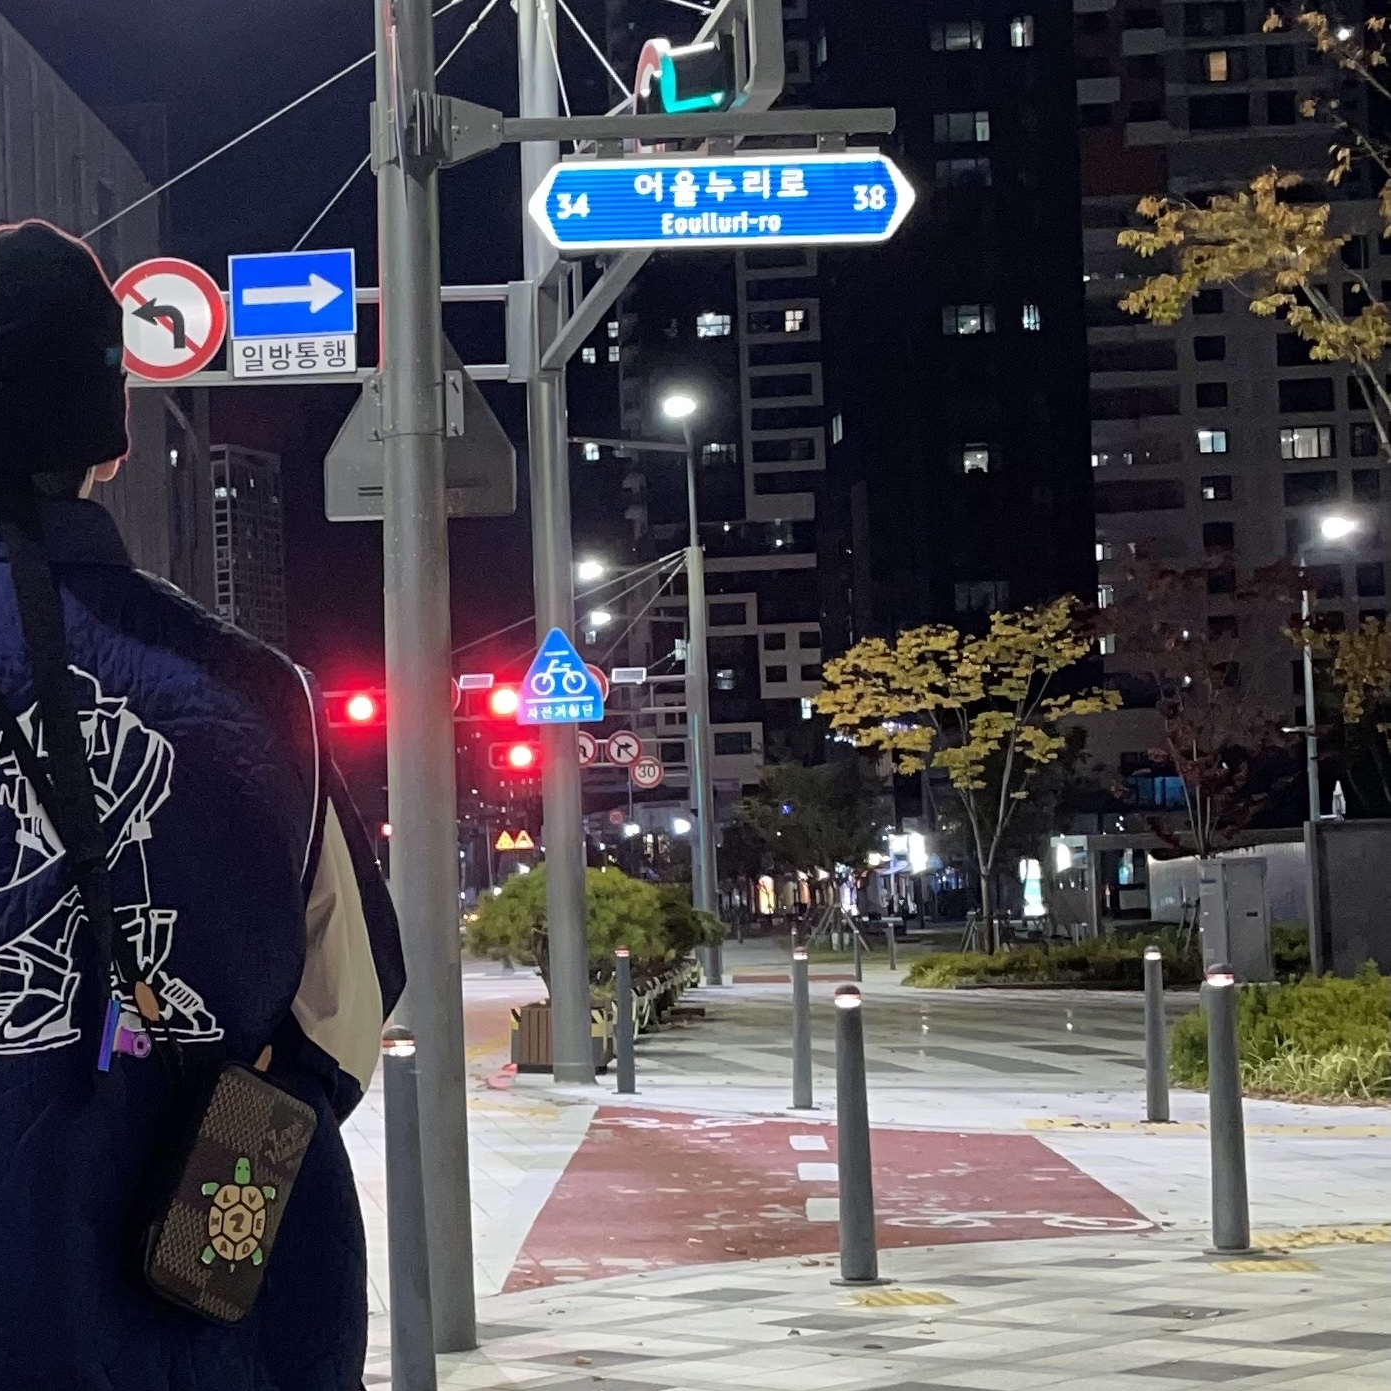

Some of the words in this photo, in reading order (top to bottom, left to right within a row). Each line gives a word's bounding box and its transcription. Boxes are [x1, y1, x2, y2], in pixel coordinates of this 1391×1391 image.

[633, 167, 809, 208] 어울누리로
[853, 184, 887, 212] 38
[556, 193, 591, 219] 34
[660, 210, 783, 236] Eoulluri-ro
[242, 339, 347, 372] 일방통행
[638, 765, 656, 778] 30
[229, 1212, 244, 1232] 2
